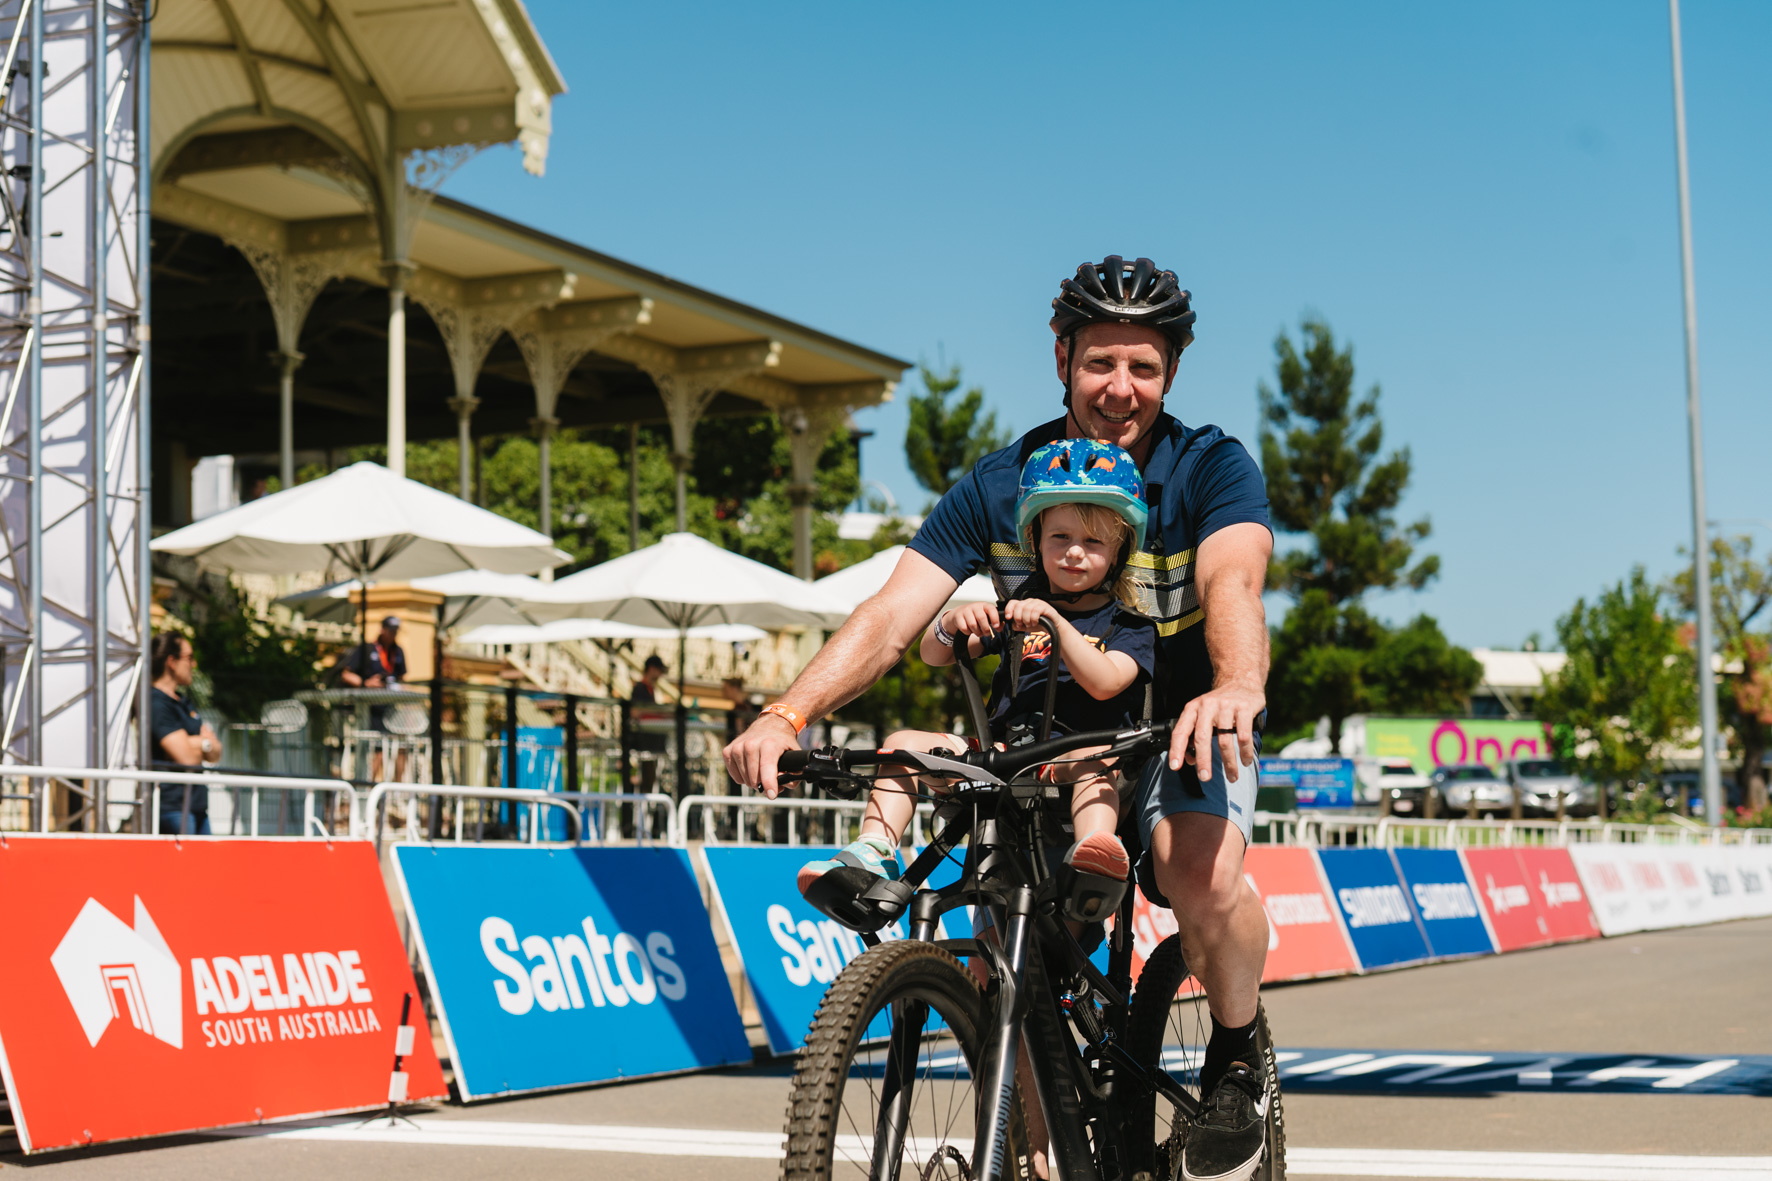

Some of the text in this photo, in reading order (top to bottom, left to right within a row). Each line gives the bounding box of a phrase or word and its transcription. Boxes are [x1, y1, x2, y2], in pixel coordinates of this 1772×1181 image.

[191, 950, 373, 1015] ADELAIDE
[480, 915, 687, 1016] Santos
[202, 1008, 381, 1048] SOUTH AUSTRALIA
[1264, 1047, 1282, 1127] PURGATORY
[1018, 1154, 1030, 1181] BU
